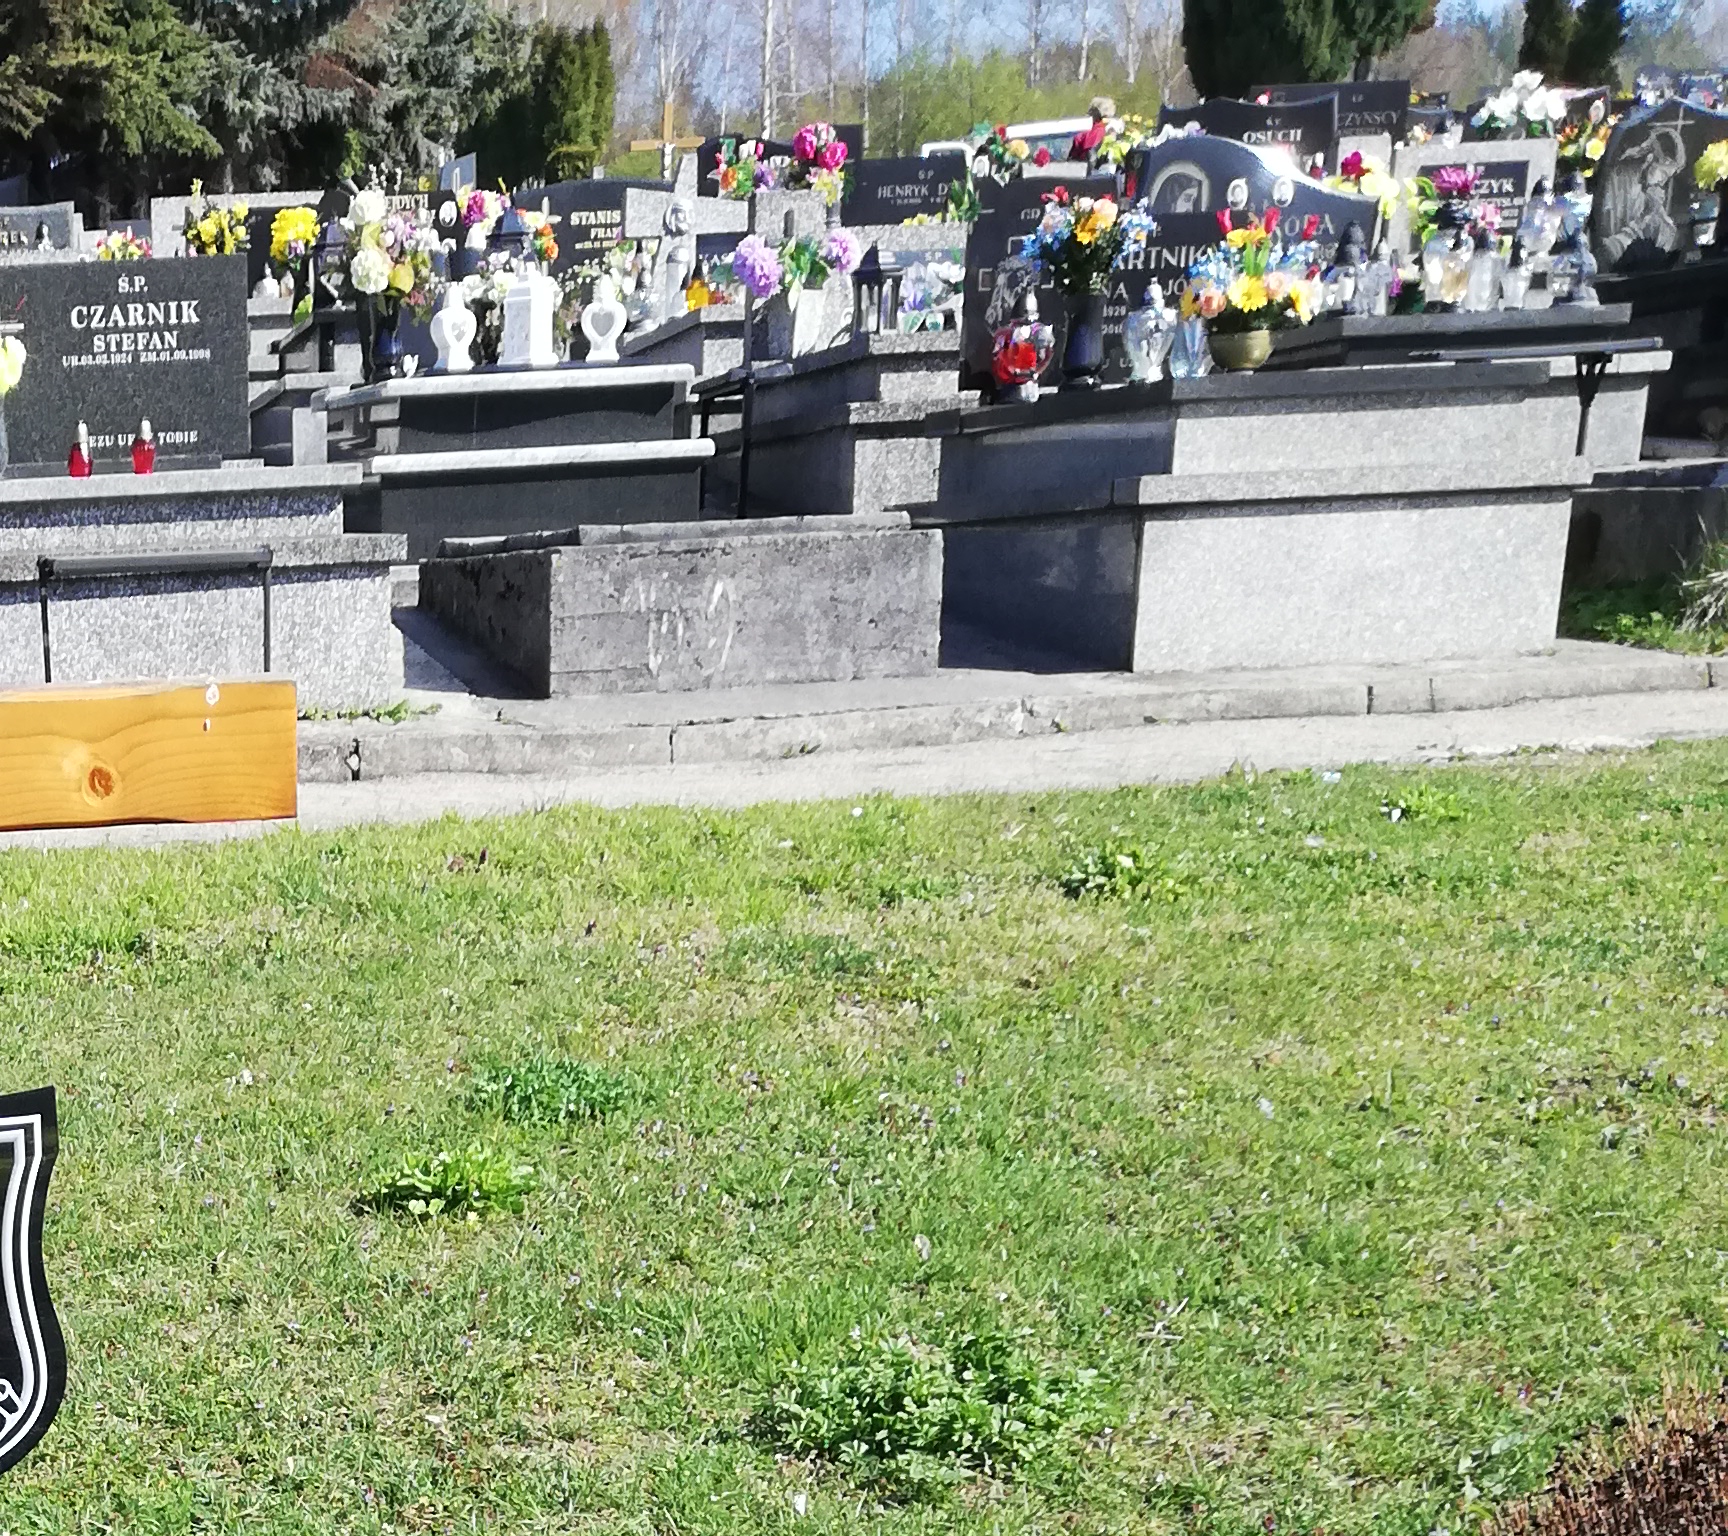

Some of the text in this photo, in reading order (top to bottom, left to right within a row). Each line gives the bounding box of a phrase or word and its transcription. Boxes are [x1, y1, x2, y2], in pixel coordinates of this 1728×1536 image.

[877, 183, 929, 199] HENRYK
[570, 210, 621, 226] STANIS
[70, 299, 201, 329] CZARNIK
[93, 330, 179, 353] STEFAN
[88, 434, 116, 448] EZU
[157, 430, 199, 444] TOBIE
